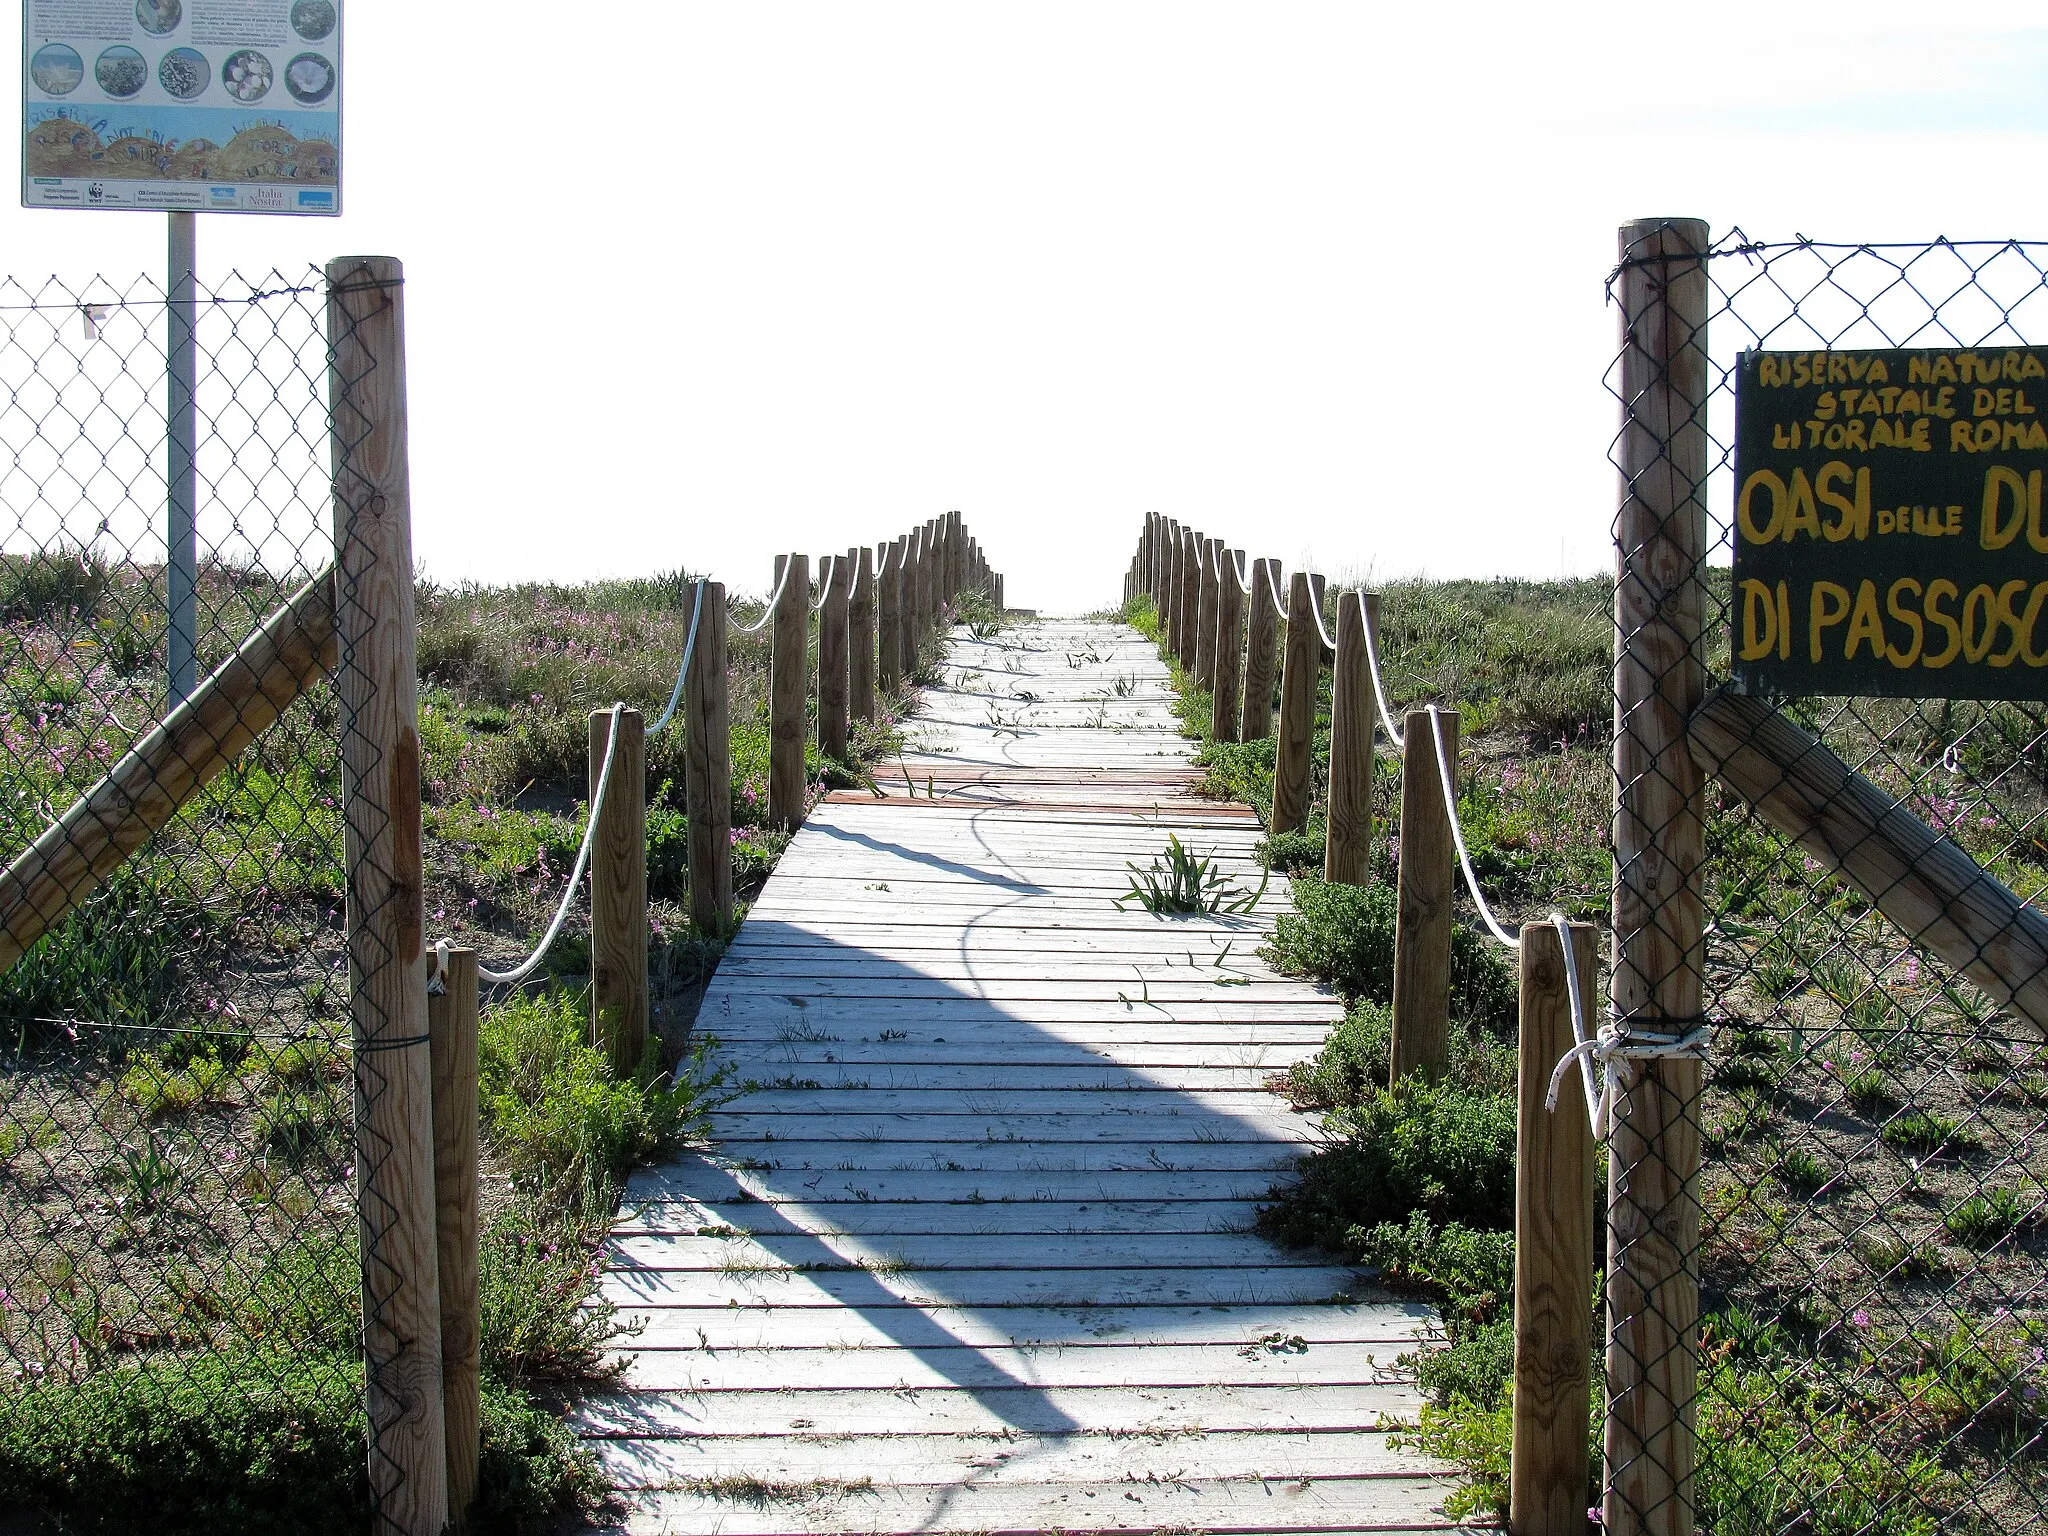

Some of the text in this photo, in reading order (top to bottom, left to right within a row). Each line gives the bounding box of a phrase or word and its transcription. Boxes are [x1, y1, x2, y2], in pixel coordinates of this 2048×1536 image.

[249, 195, 281, 207] Nostra
[258, 188, 282, 198] Italia
[1759, 350, 2046, 388] RISERVA NATURA
[1814, 386, 2035, 420] STATALE DEL
[1772, 417, 2048, 453] LITORALE ROMA
[1737, 460, 1871, 545] OASI
[1876, 505, 1963, 536] DELLE
[1738, 578, 1790, 662] DI
